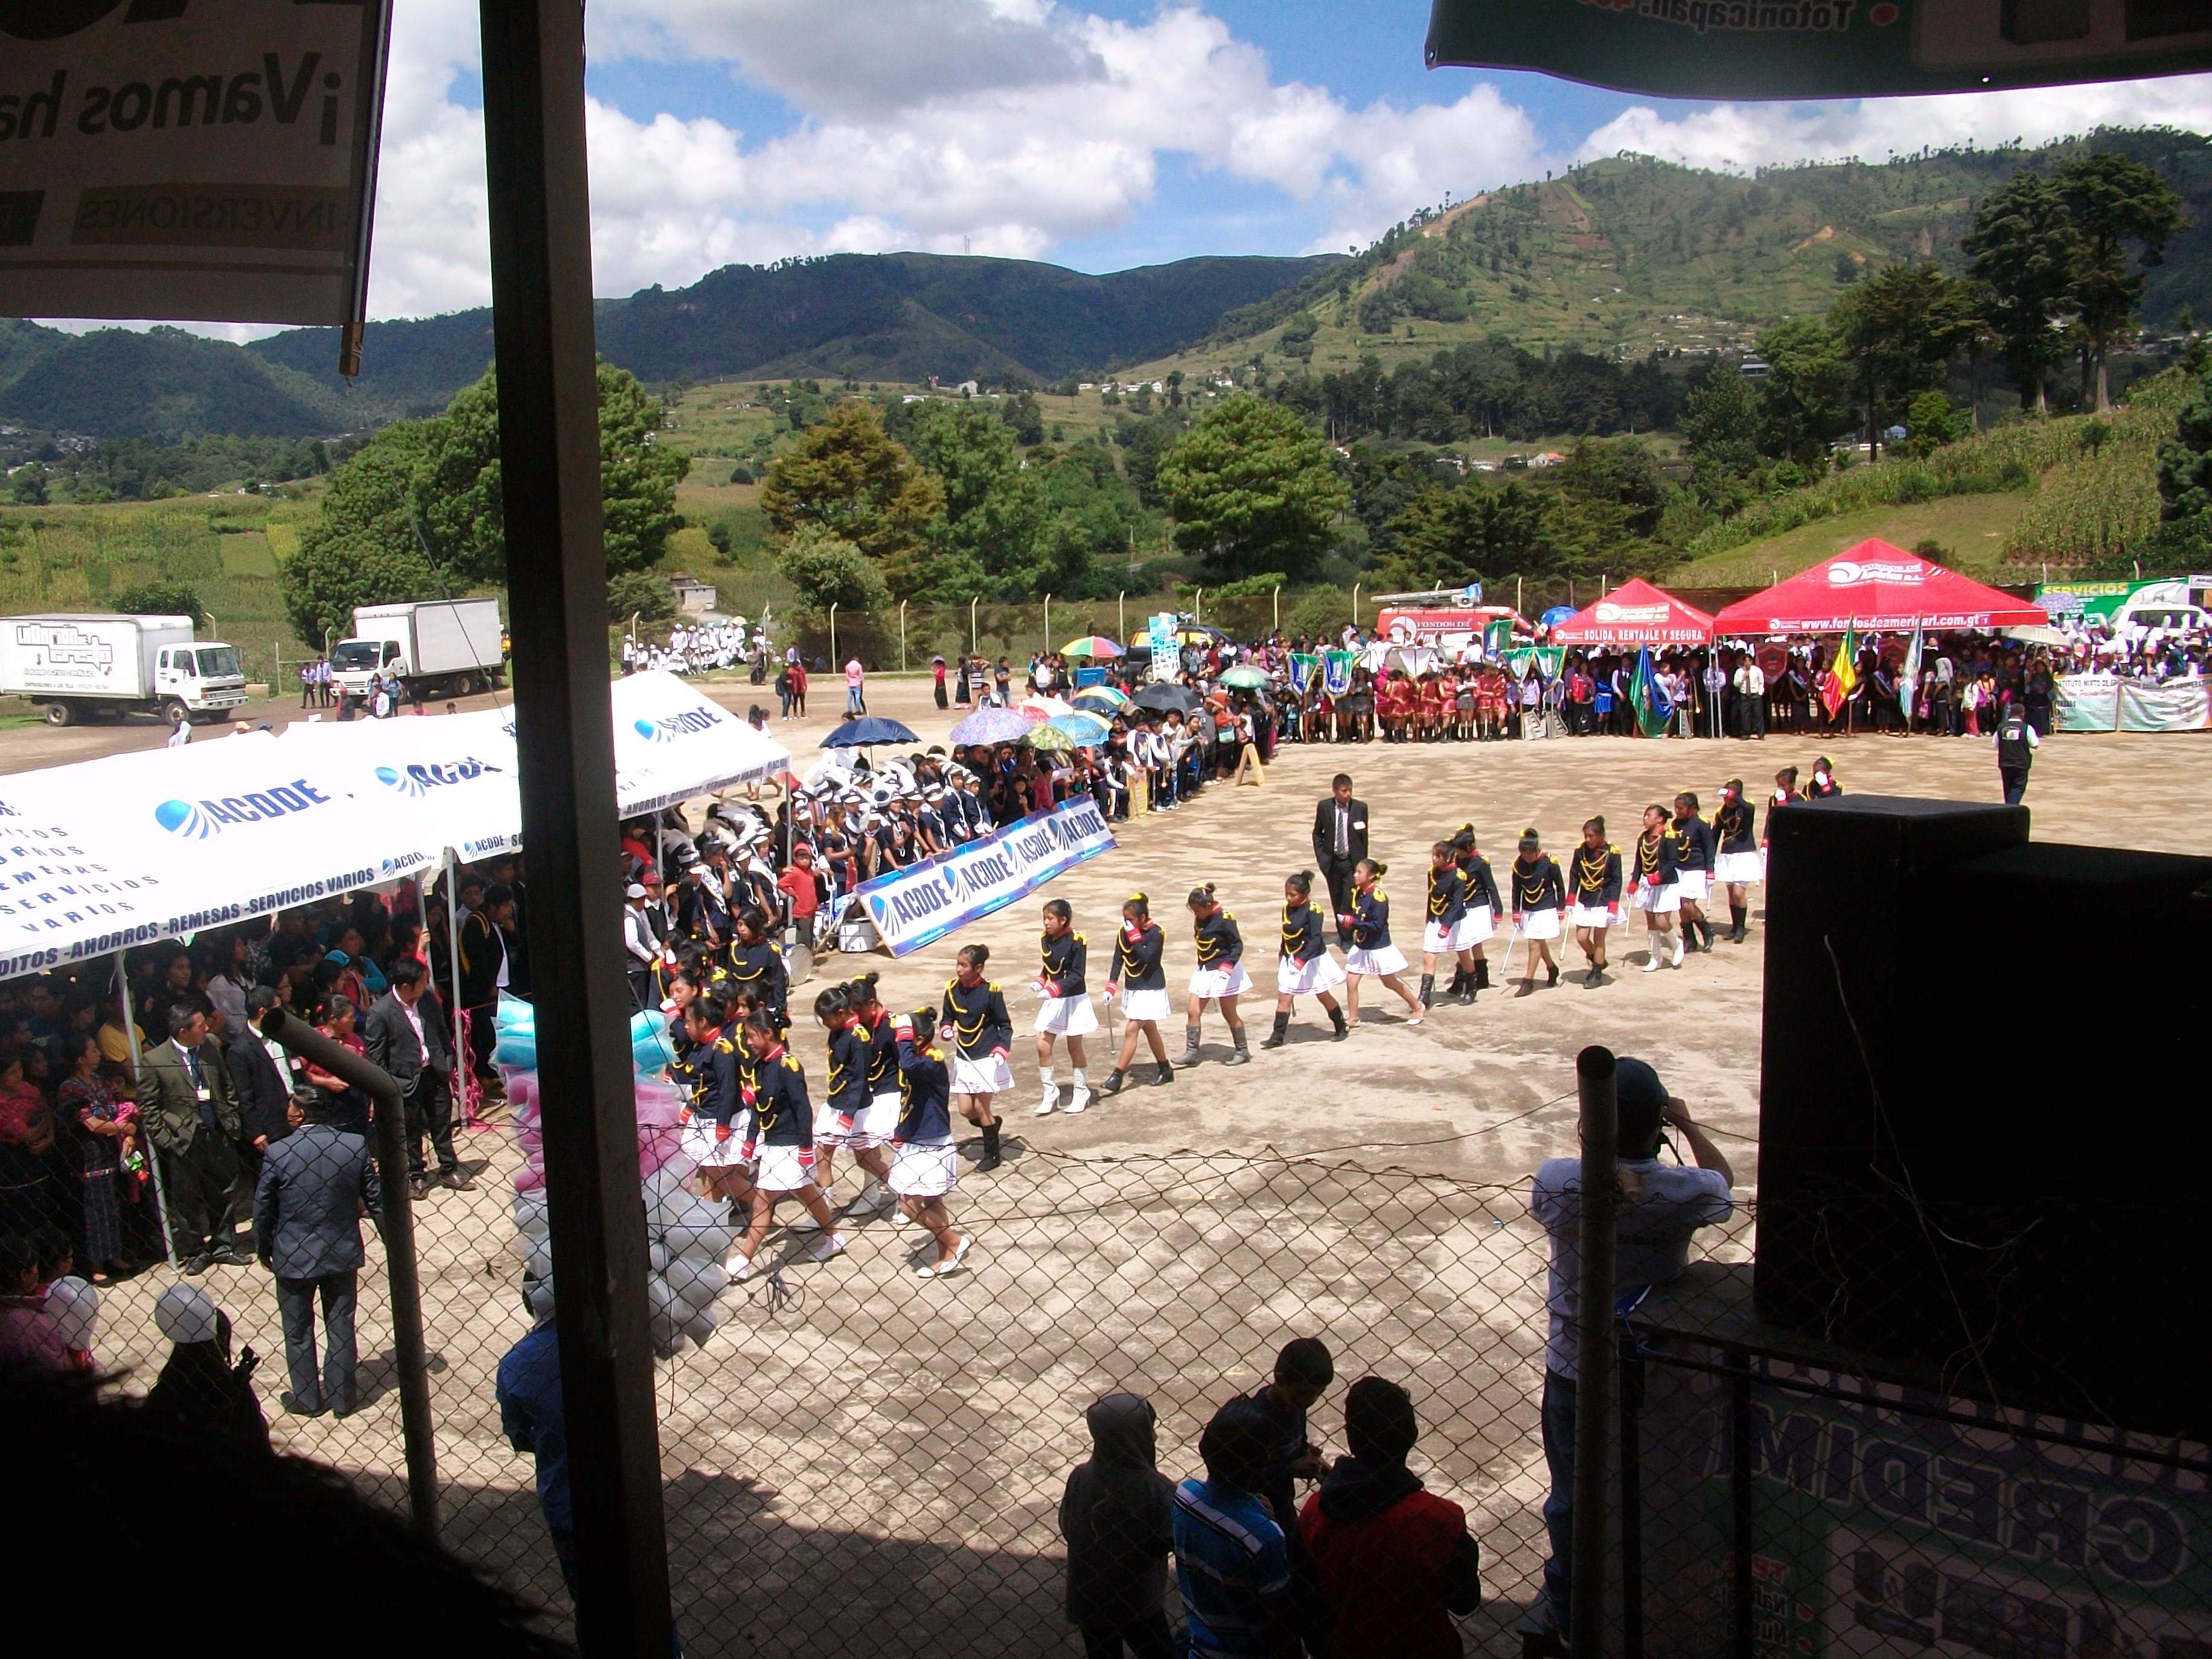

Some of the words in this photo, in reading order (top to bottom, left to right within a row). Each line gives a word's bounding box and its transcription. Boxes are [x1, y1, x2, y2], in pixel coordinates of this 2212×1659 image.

[1662, 630, 1667, 641] Y
[1801, 615, 1980, 630] www.fonosdeameriarl.com.gt
[199, 778, 331, 824] ACDDE
[0, 827, 68, 839] ITOS
[327, 868, 376, 893] VARIOS
[394, 852, 429, 870] ACDD
[891, 878, 952, 925] ACDDE
[960, 852, 1013, 893] ACDDE
[1059, 809, 1105, 845] ACDDE
[0, 876, 159, 915] SERVICIOS
[21, 902, 135, 932] VARIOS
